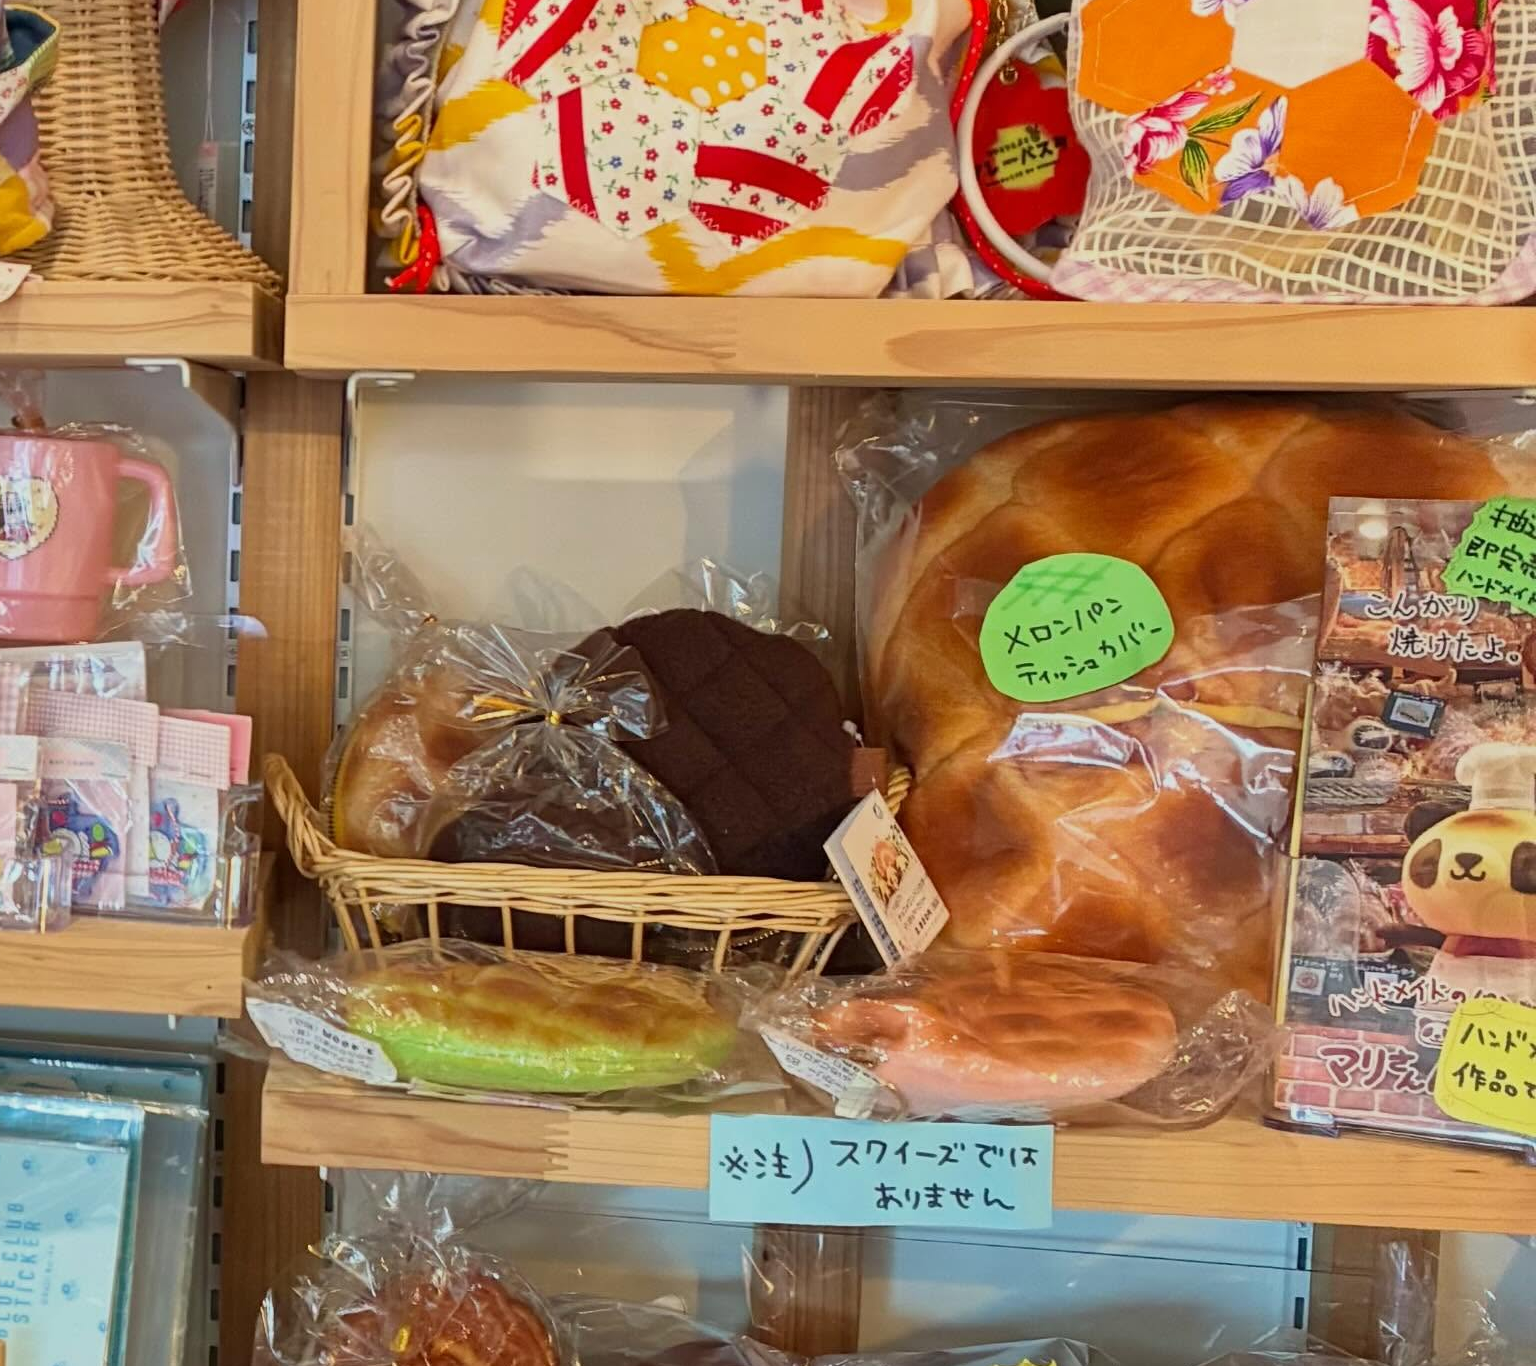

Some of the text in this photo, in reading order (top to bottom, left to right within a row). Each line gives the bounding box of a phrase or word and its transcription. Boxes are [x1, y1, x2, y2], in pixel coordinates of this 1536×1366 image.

[1004, 597, 1124, 655] メロンパン
[1366, 592, 1478, 623] こんがり
[1390, 626, 1520, 663] 焼けたよ。
[829, 1139, 1040, 1168] スクイーズでは
[874, 1182, 1016, 1211] ありません
[1, 1202, 25, 1262] CLUB
[13, 1220, 42, 1324] STICKER
